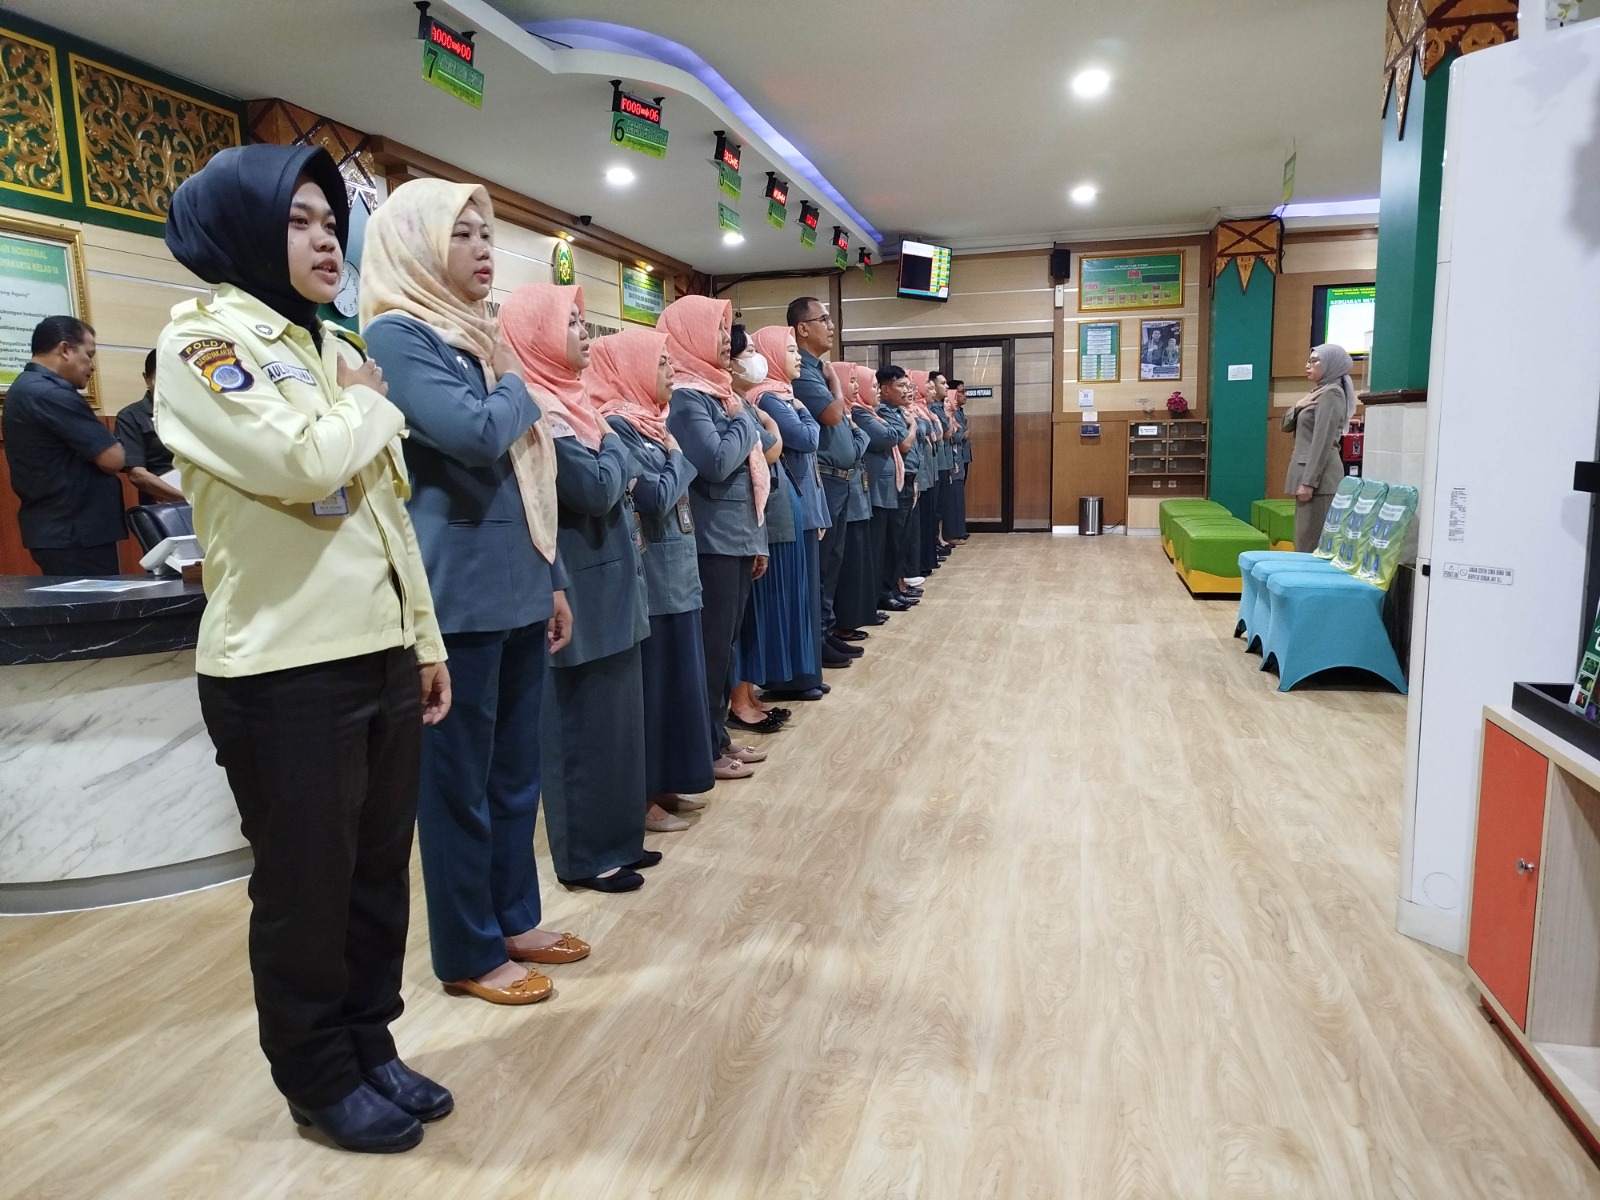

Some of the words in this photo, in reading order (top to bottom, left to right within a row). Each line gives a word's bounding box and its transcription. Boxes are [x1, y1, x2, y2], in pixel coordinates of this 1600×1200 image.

[426, 46, 439, 79] 7
[614, 118, 625, 142] 6
[719, 165, 726, 187] 5
[185, 340, 227, 355] POLDA
